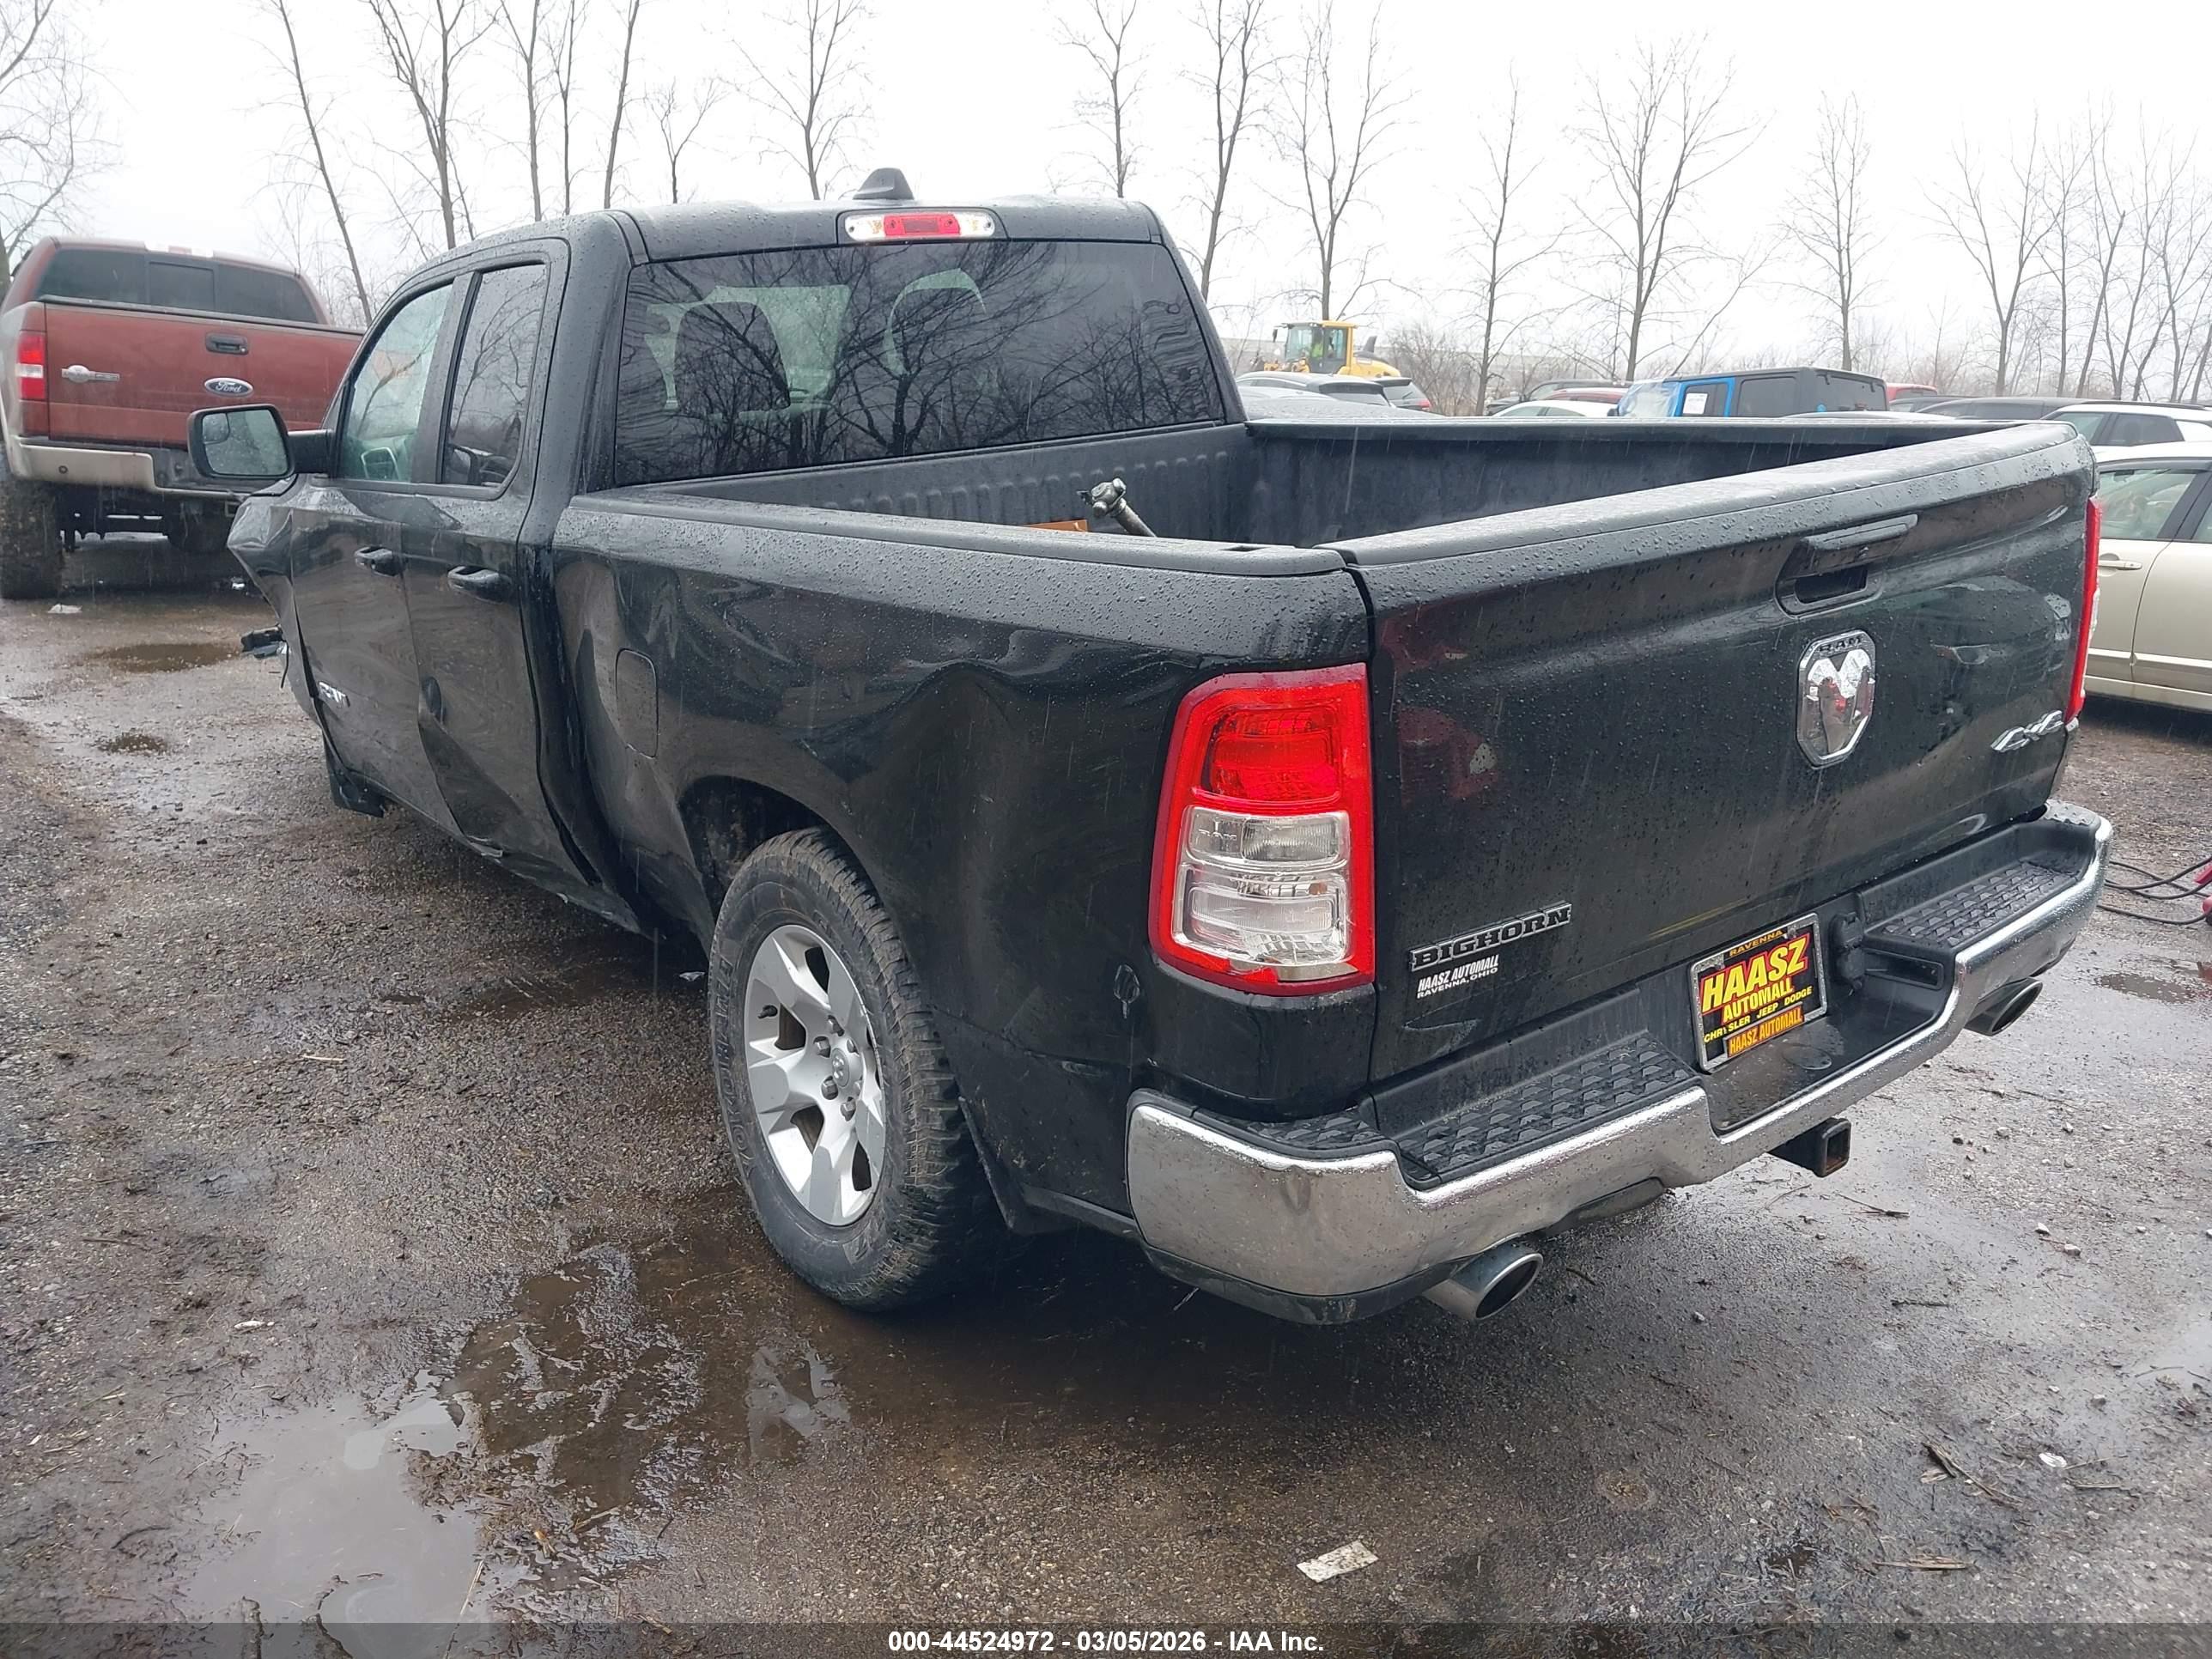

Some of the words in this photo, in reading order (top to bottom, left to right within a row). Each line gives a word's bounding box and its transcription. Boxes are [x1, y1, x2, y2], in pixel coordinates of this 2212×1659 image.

[215, 381, 242, 394] Ford
[1409, 901, 1573, 972] BIGHORN
[1729, 929, 1786, 957] RAVENNA
[1417, 969, 1451, 993] HAASZ
[1451, 954, 1499, 981] AUTOMALL
[1701, 934, 1808, 1014] HAASZ
[1723, 978, 1794, 1023] AUTOMALL
[1756, 1002, 1779, 1020] JEEP
[1784, 985, 1813, 1006] DODGE
[1729, 1030, 1759, 1056] HAASZ
[1759, 1009, 1803, 1041] AUTOMALL
